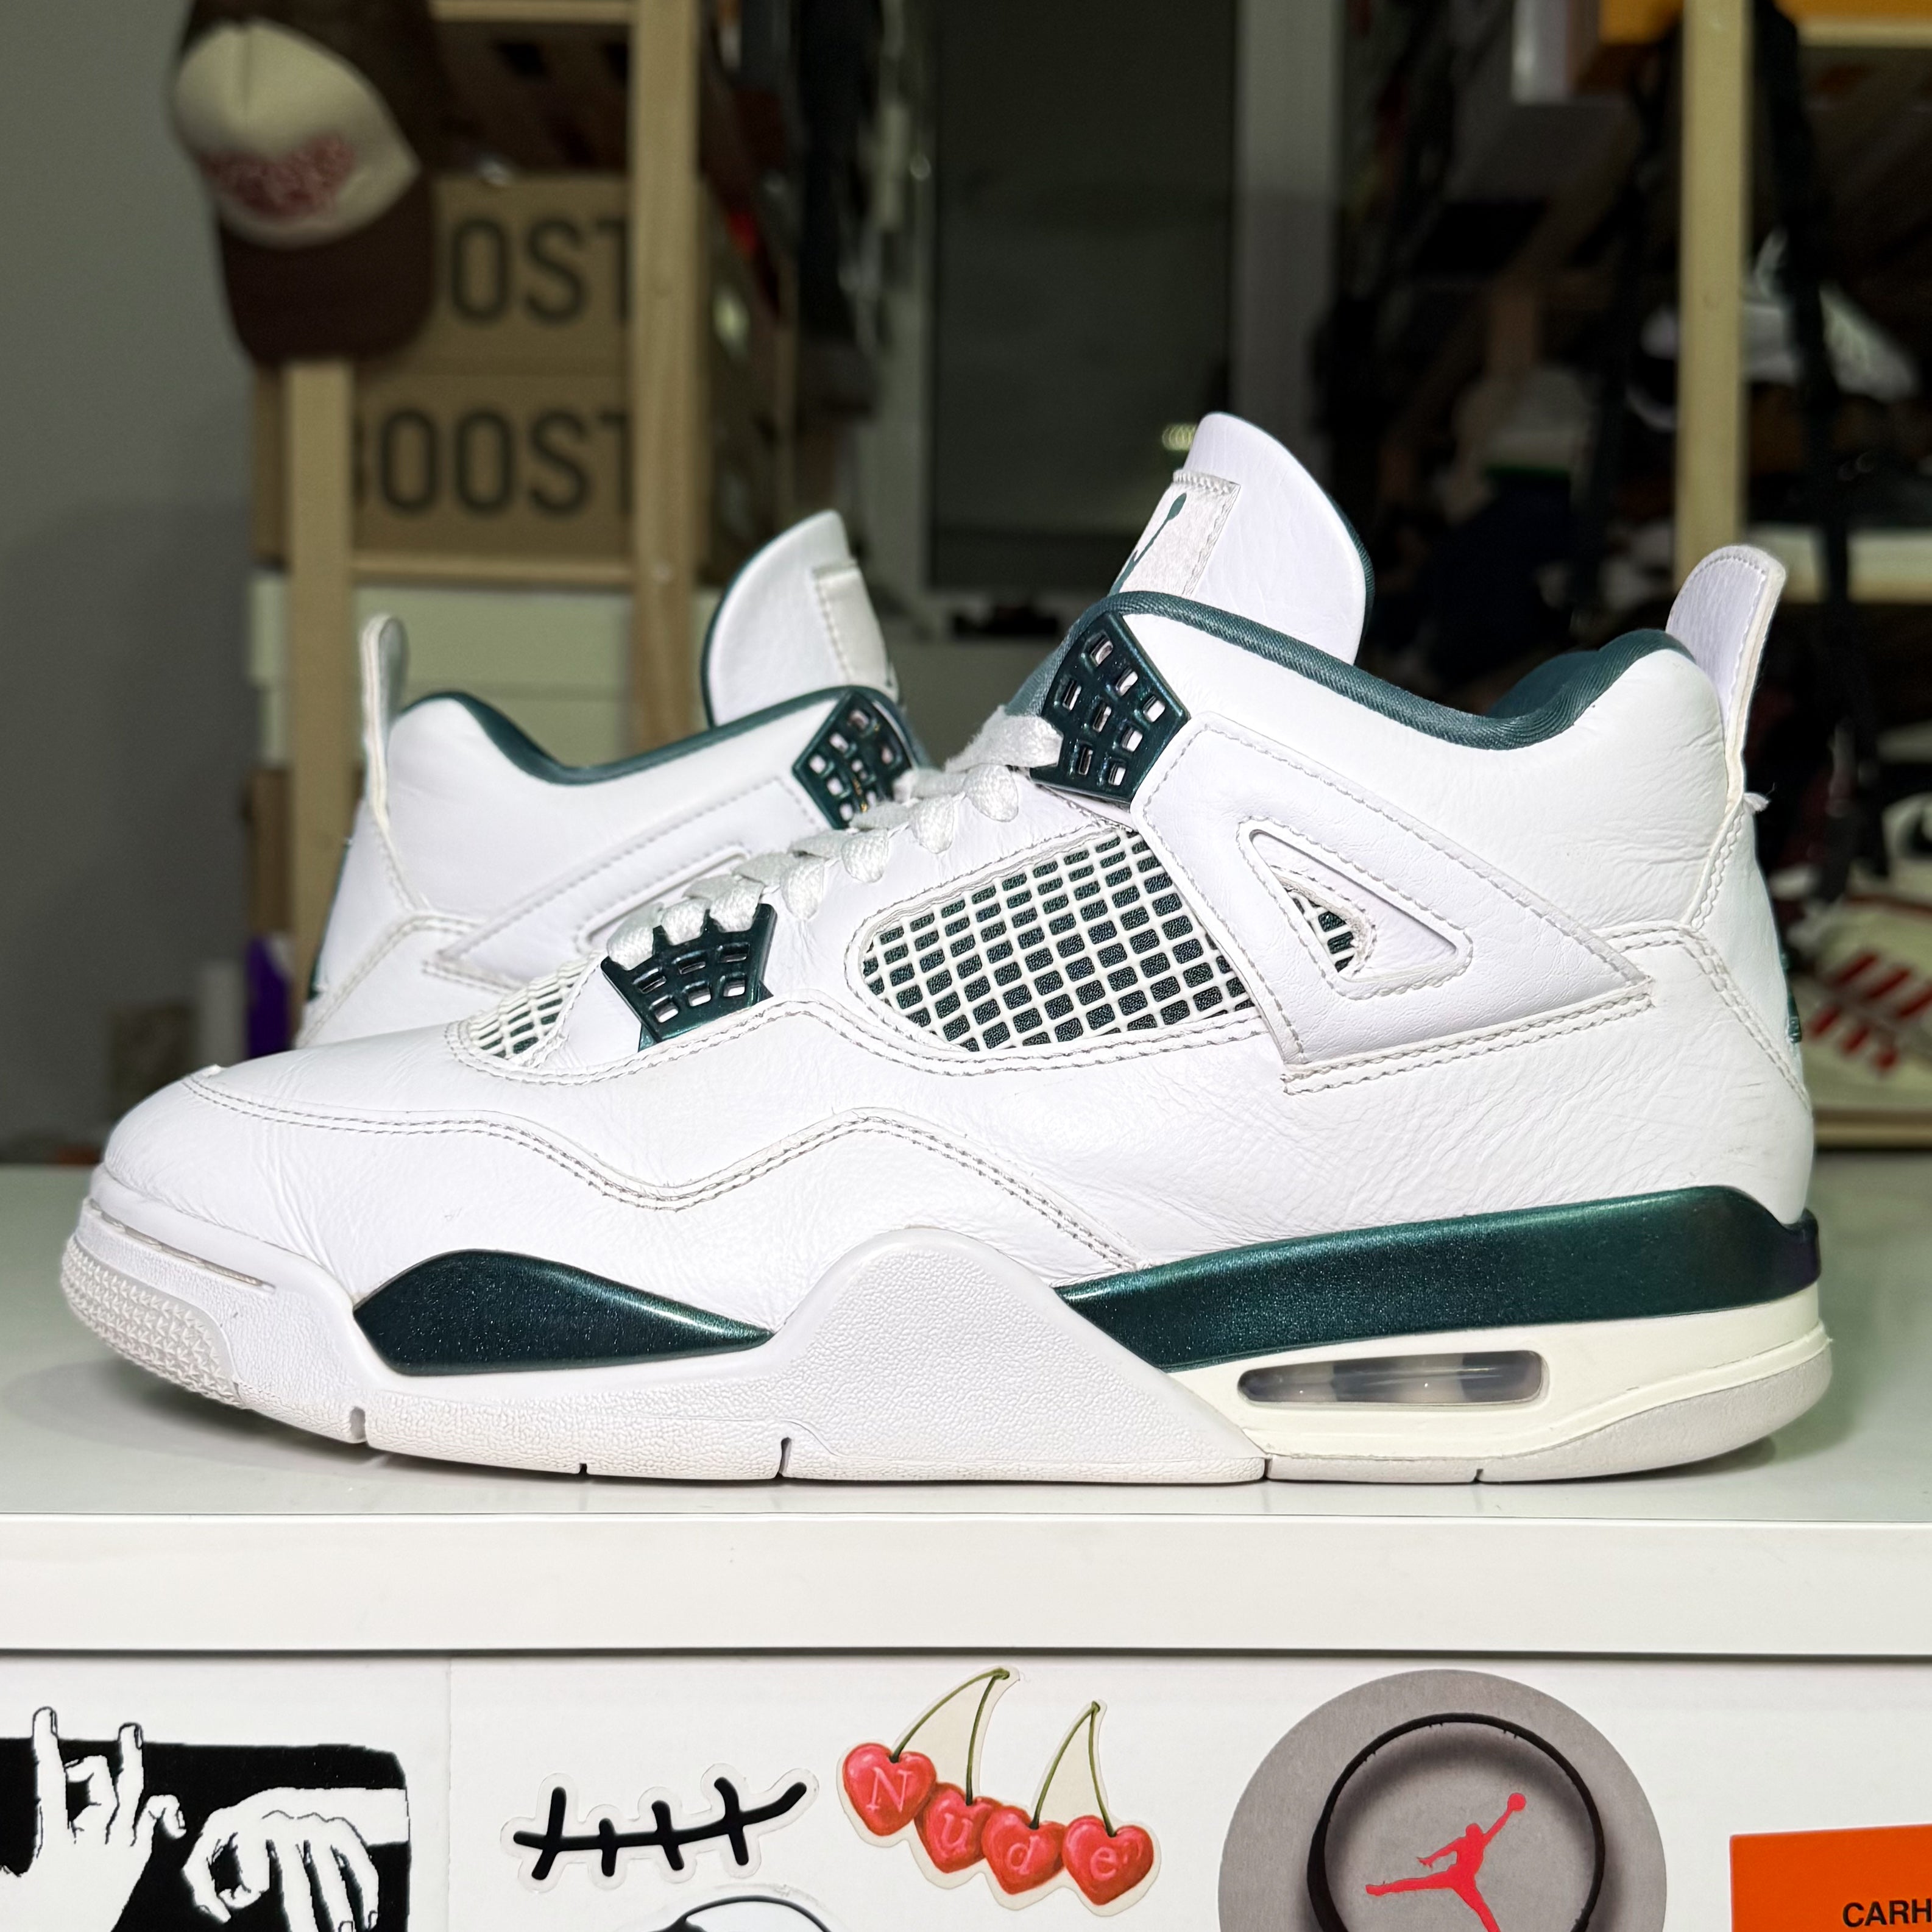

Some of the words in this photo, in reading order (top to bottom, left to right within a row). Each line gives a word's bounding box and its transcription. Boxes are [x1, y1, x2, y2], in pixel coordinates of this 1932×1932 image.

[355, 406, 630, 515] OOST
[866, 1767, 1120, 1880] Nude
[1842, 1898, 1932, 1927] CARH
